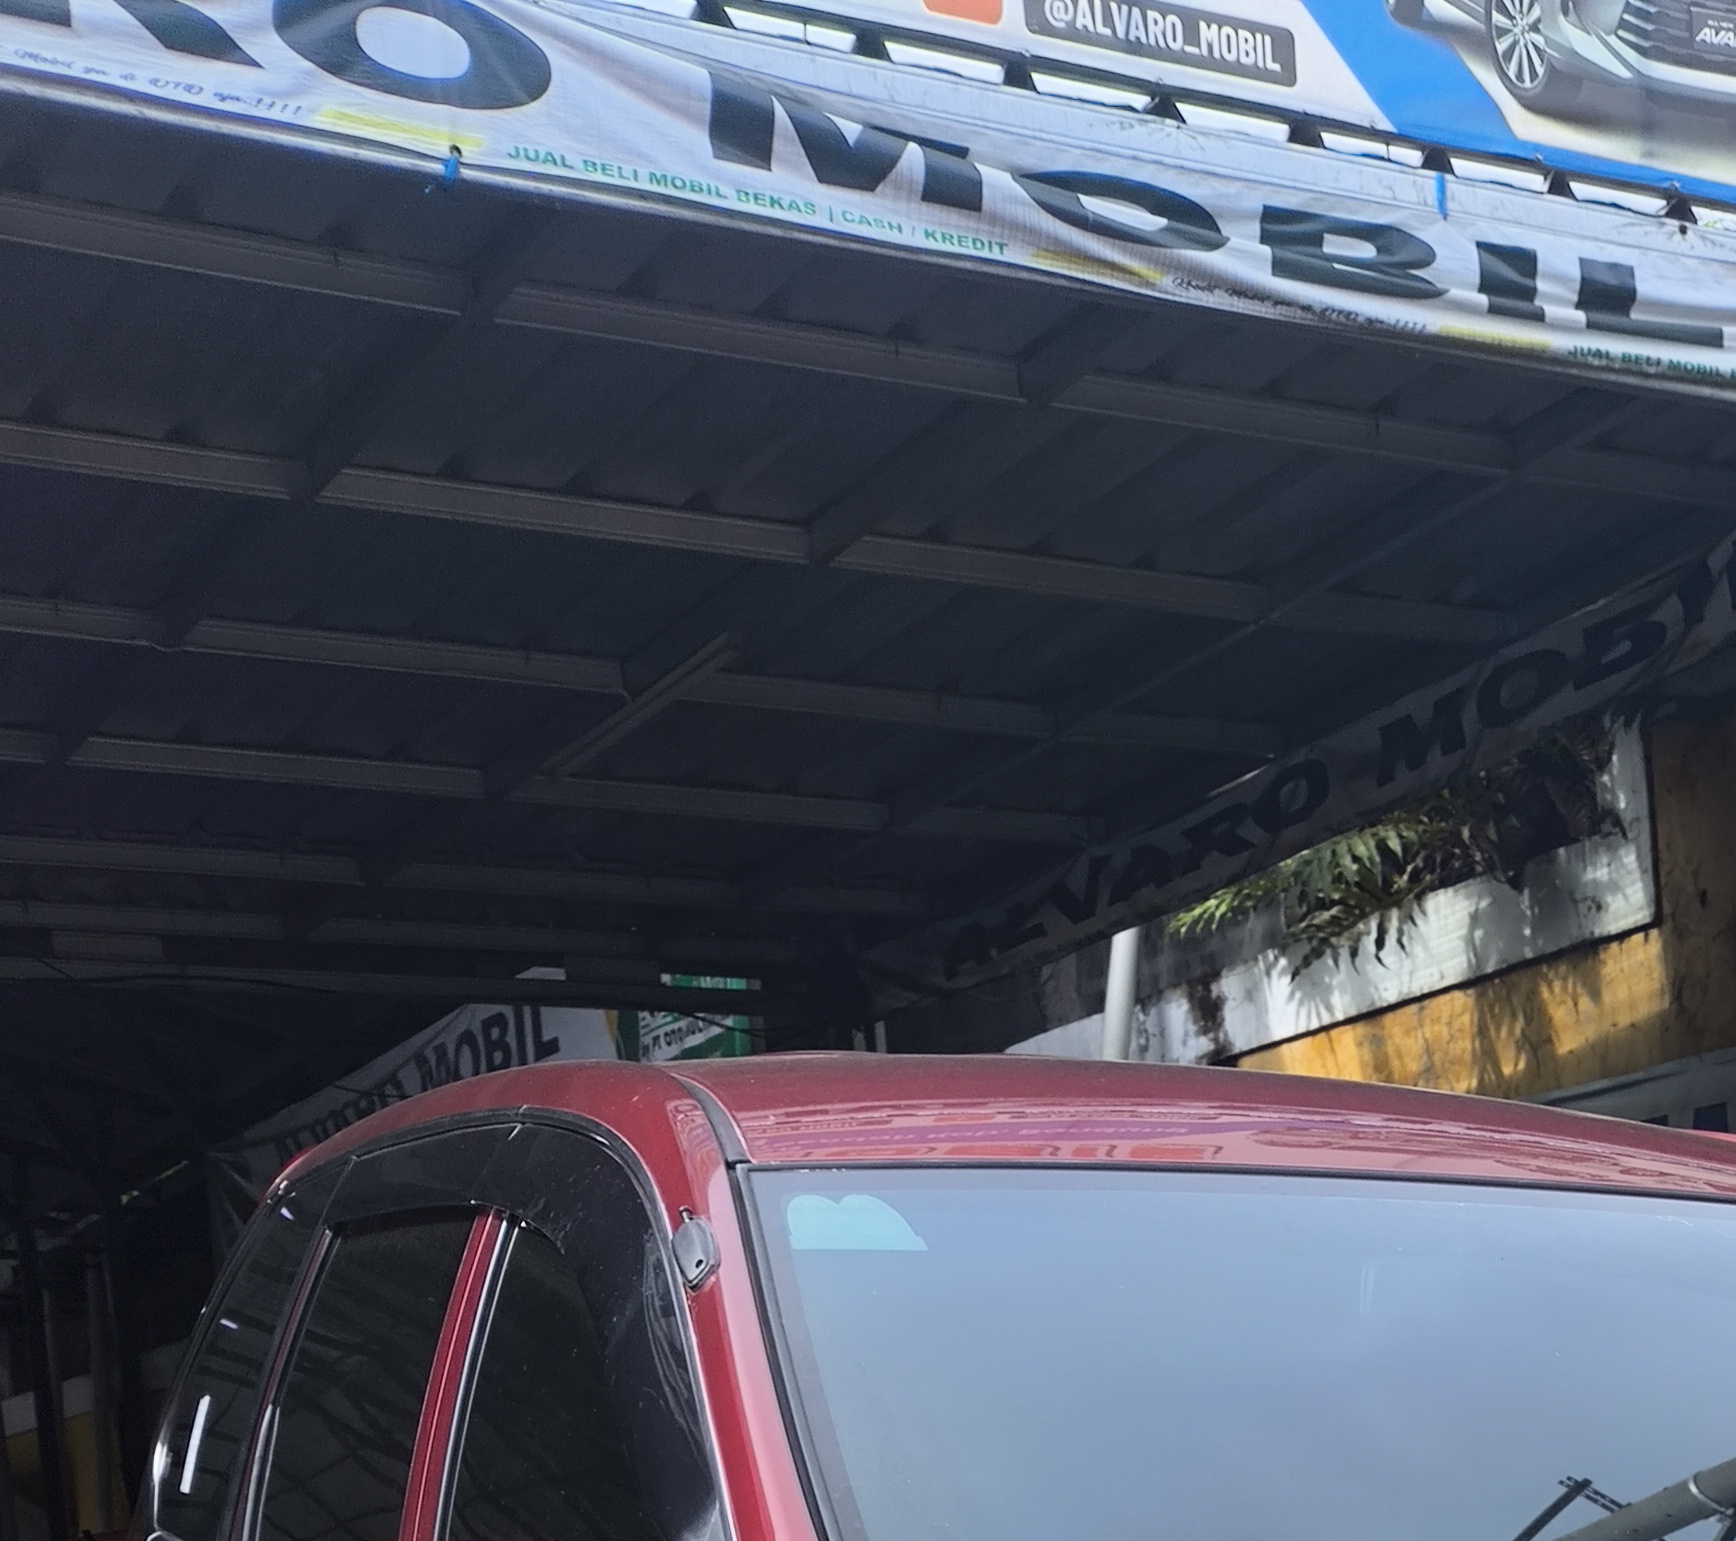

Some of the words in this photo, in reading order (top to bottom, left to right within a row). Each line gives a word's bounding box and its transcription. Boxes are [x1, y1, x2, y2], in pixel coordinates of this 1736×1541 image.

[1043, 0, 1282, 73] @ALVARO_MOBIL
[507, 145, 574, 171] JUAL
[582, 159, 639, 183] BELI
[649, 171, 728, 200] MOBIL
[736, 190, 817, 217] BEKAS
[842, 210, 903, 236] CASH
[923, 228, 1009, 257] KREDIT
[708, 66, 1724, 349] MOBIL
[1568, 344, 1613, 361] JUAL
[1621, 352, 1661, 367] BELI
[1668, 359, 1722, 378] MOBIL
[415, 1004, 561, 1092] MOBIL
